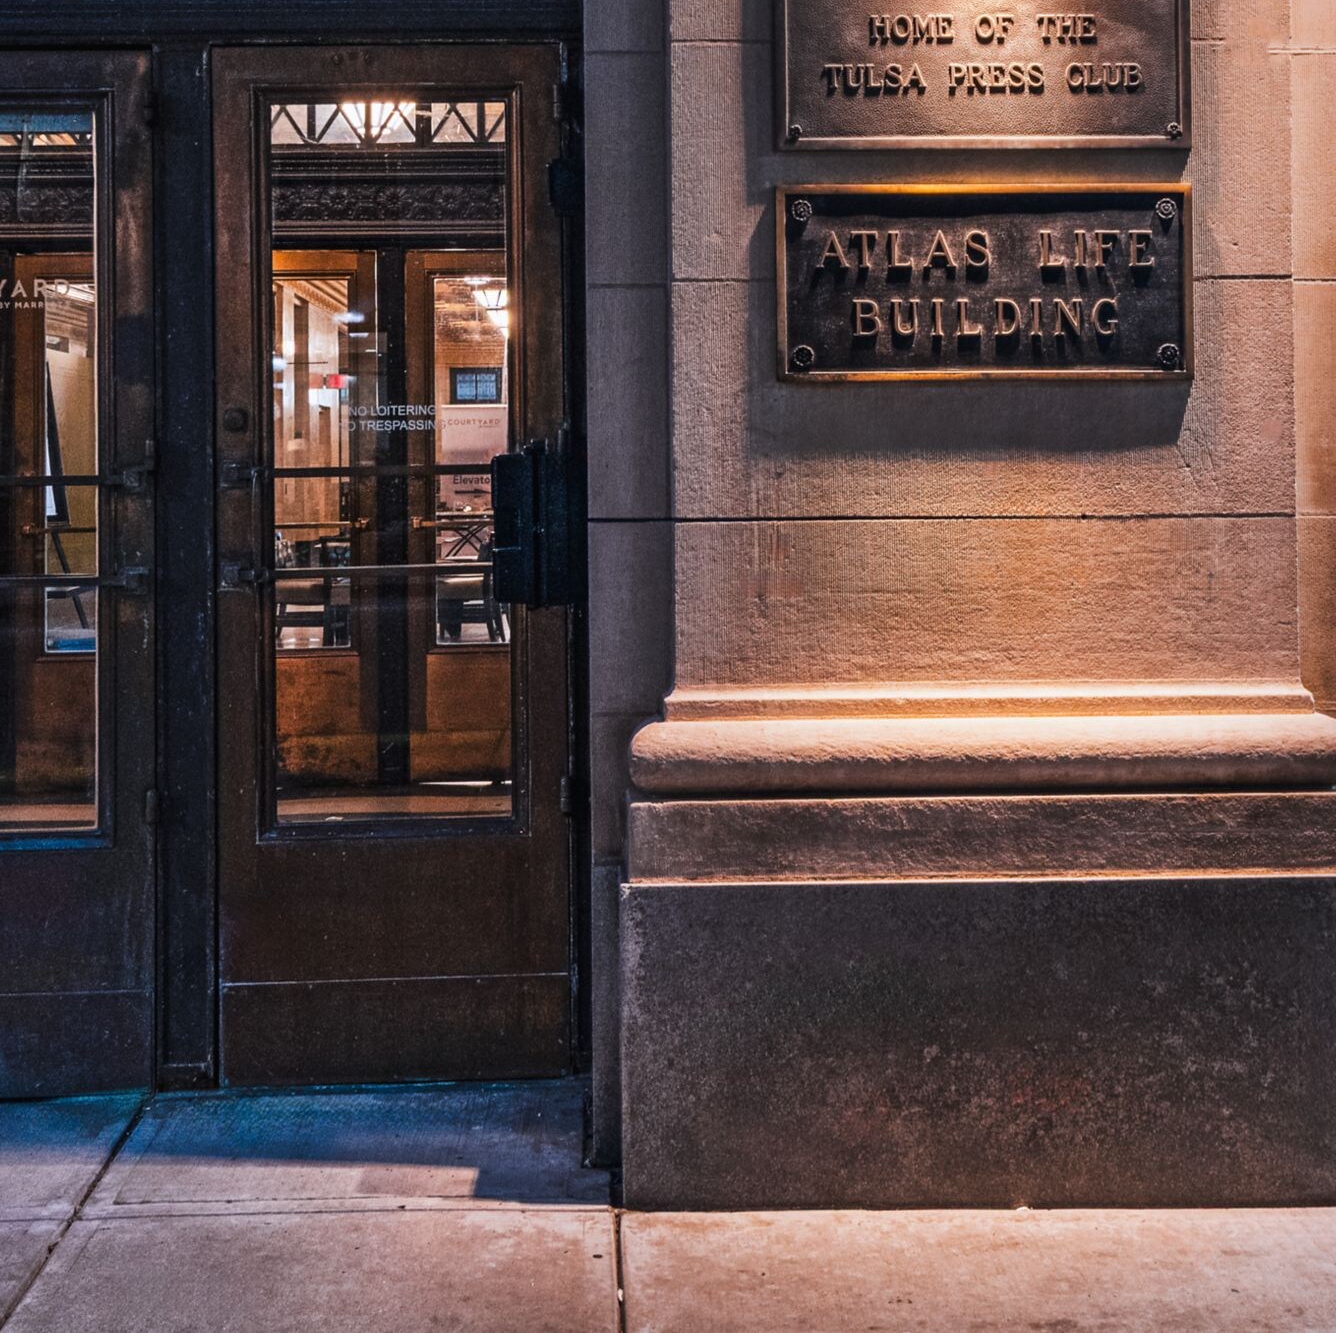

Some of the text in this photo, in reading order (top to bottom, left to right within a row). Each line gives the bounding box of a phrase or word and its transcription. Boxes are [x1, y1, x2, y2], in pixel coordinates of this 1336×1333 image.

[869, 13, 1097, 43] HOME OF THE
[824, 61, 1143, 91] TULSA PRESS CLUB
[816, 229, 1155, 268] ATLAS LIFE
[851, 296, 1121, 337] BUILDING
[349, 405, 436, 416] NO LOITERING
[359, 419, 446, 431] TRESPASSING
[447, 418, 500, 426] COURTYARD
[453, 474, 491, 485] Elevato
